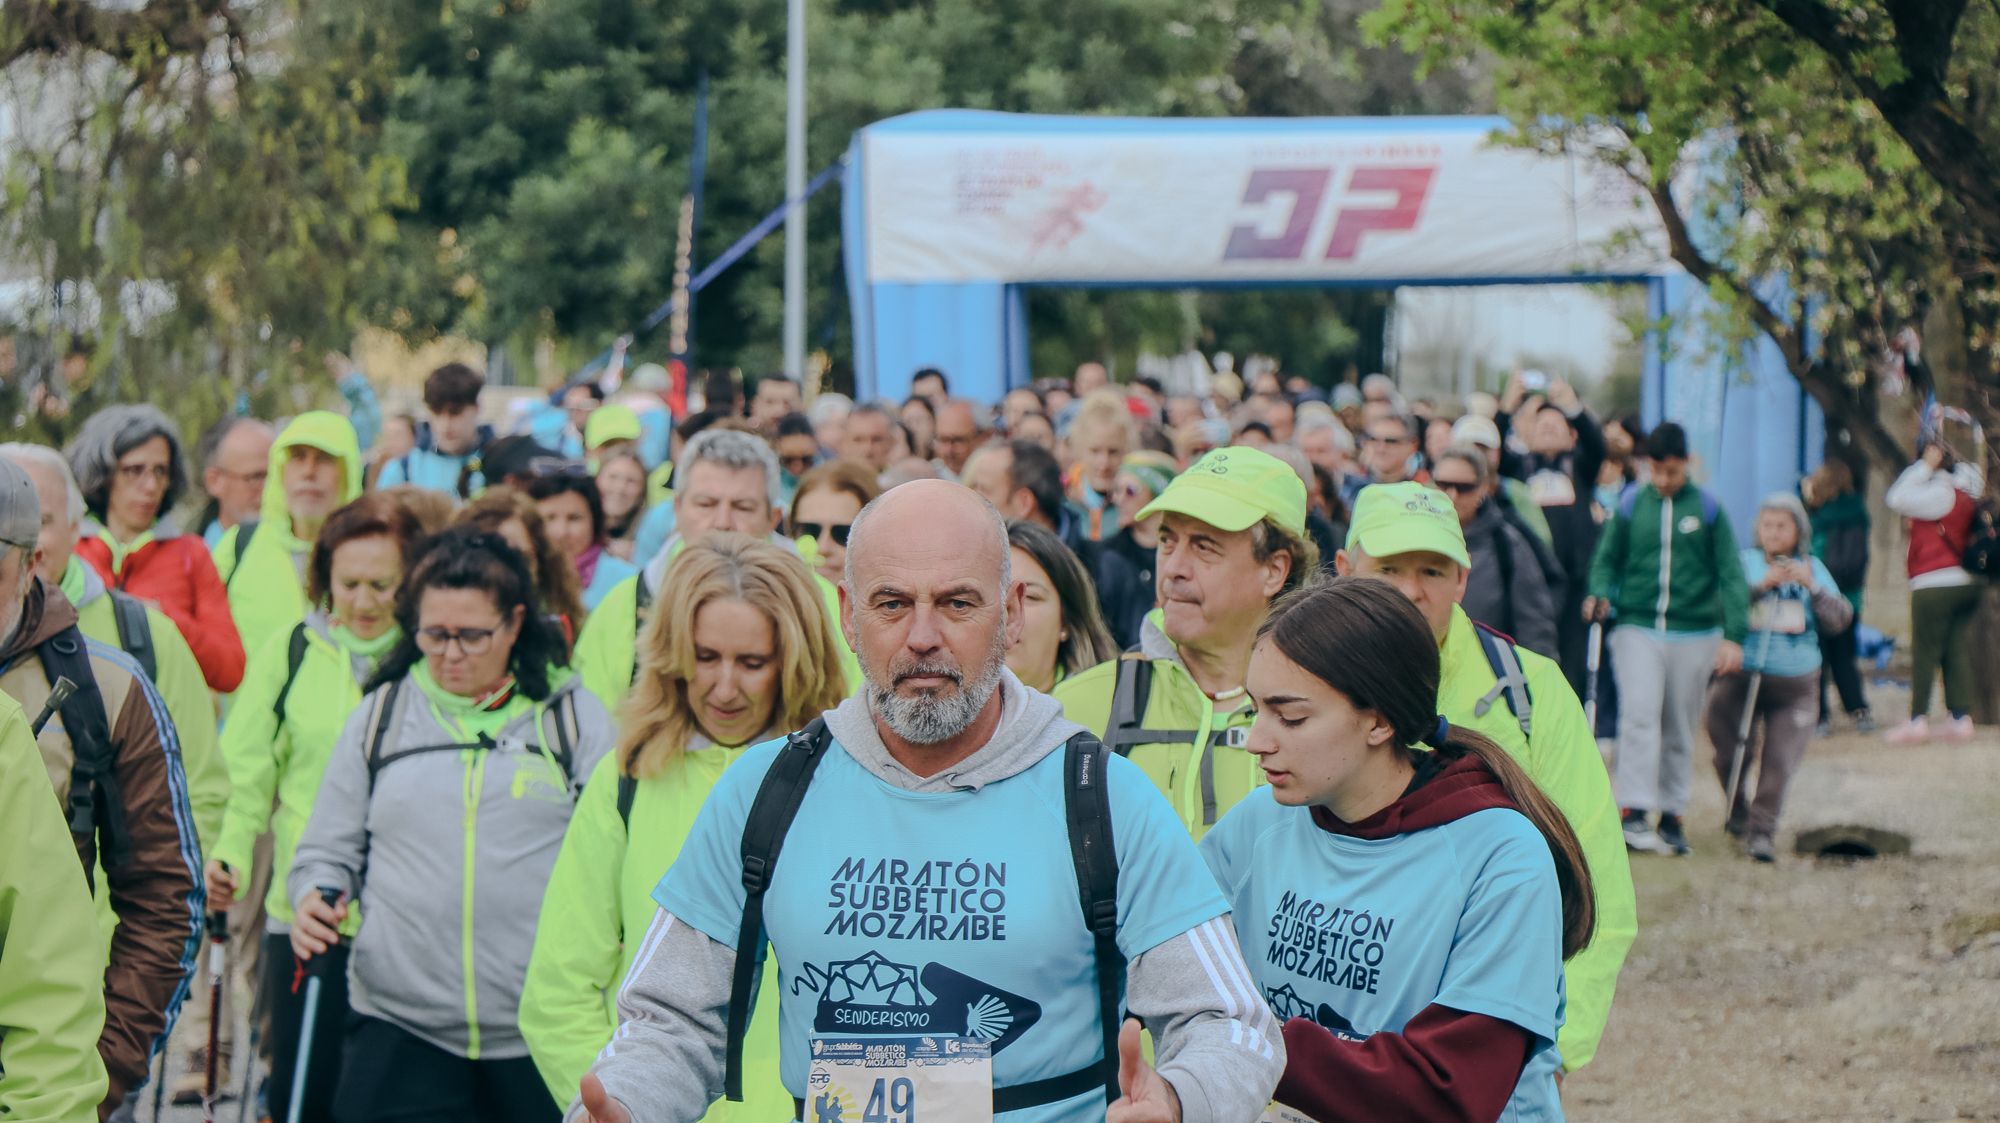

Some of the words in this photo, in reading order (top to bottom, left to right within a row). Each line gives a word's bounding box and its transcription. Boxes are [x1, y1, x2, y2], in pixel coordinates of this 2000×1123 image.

[831, 856, 1007, 888] MARATÓN
[828, 883, 1006, 914] SUBBÉTICO
[824, 910, 1007, 941] MOZÁRABE
[1276, 889, 1395, 943] MARATÓN
[1268, 914, 1384, 967] SUBBÉTICO
[1267, 940, 1381, 995] MOZÁRABE
[834, 1008, 930, 1027] SENDERISMO
[810, 1074, 831, 1083] SPG
[862, 1077, 915, 1123] 49
